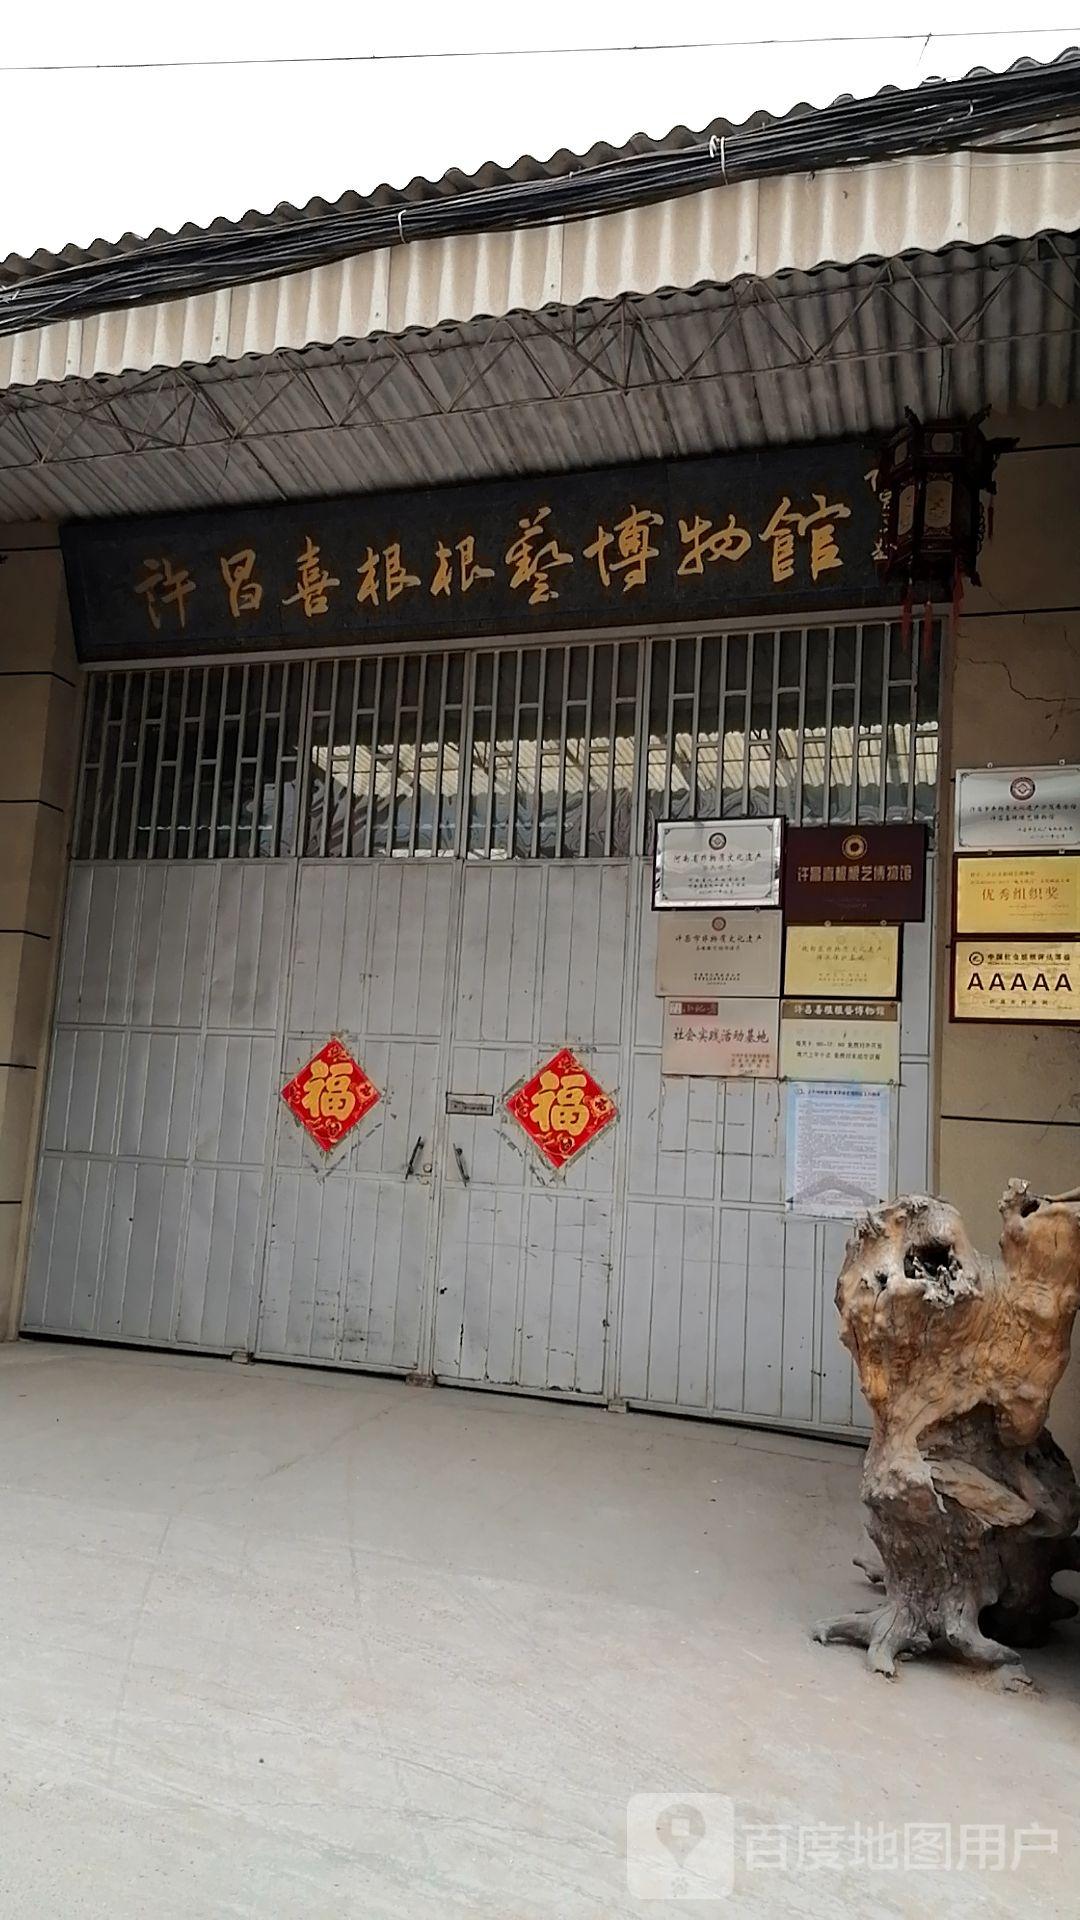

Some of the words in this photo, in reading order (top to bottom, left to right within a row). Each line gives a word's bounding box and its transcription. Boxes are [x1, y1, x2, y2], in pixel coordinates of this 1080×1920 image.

[982, 886, 1059, 901] 优秀组织奖
[673, 1026, 770, 1043] 社会实践活动基地
[301, 1059, 356, 1122] 福
[529, 1069, 591, 1137] 福
